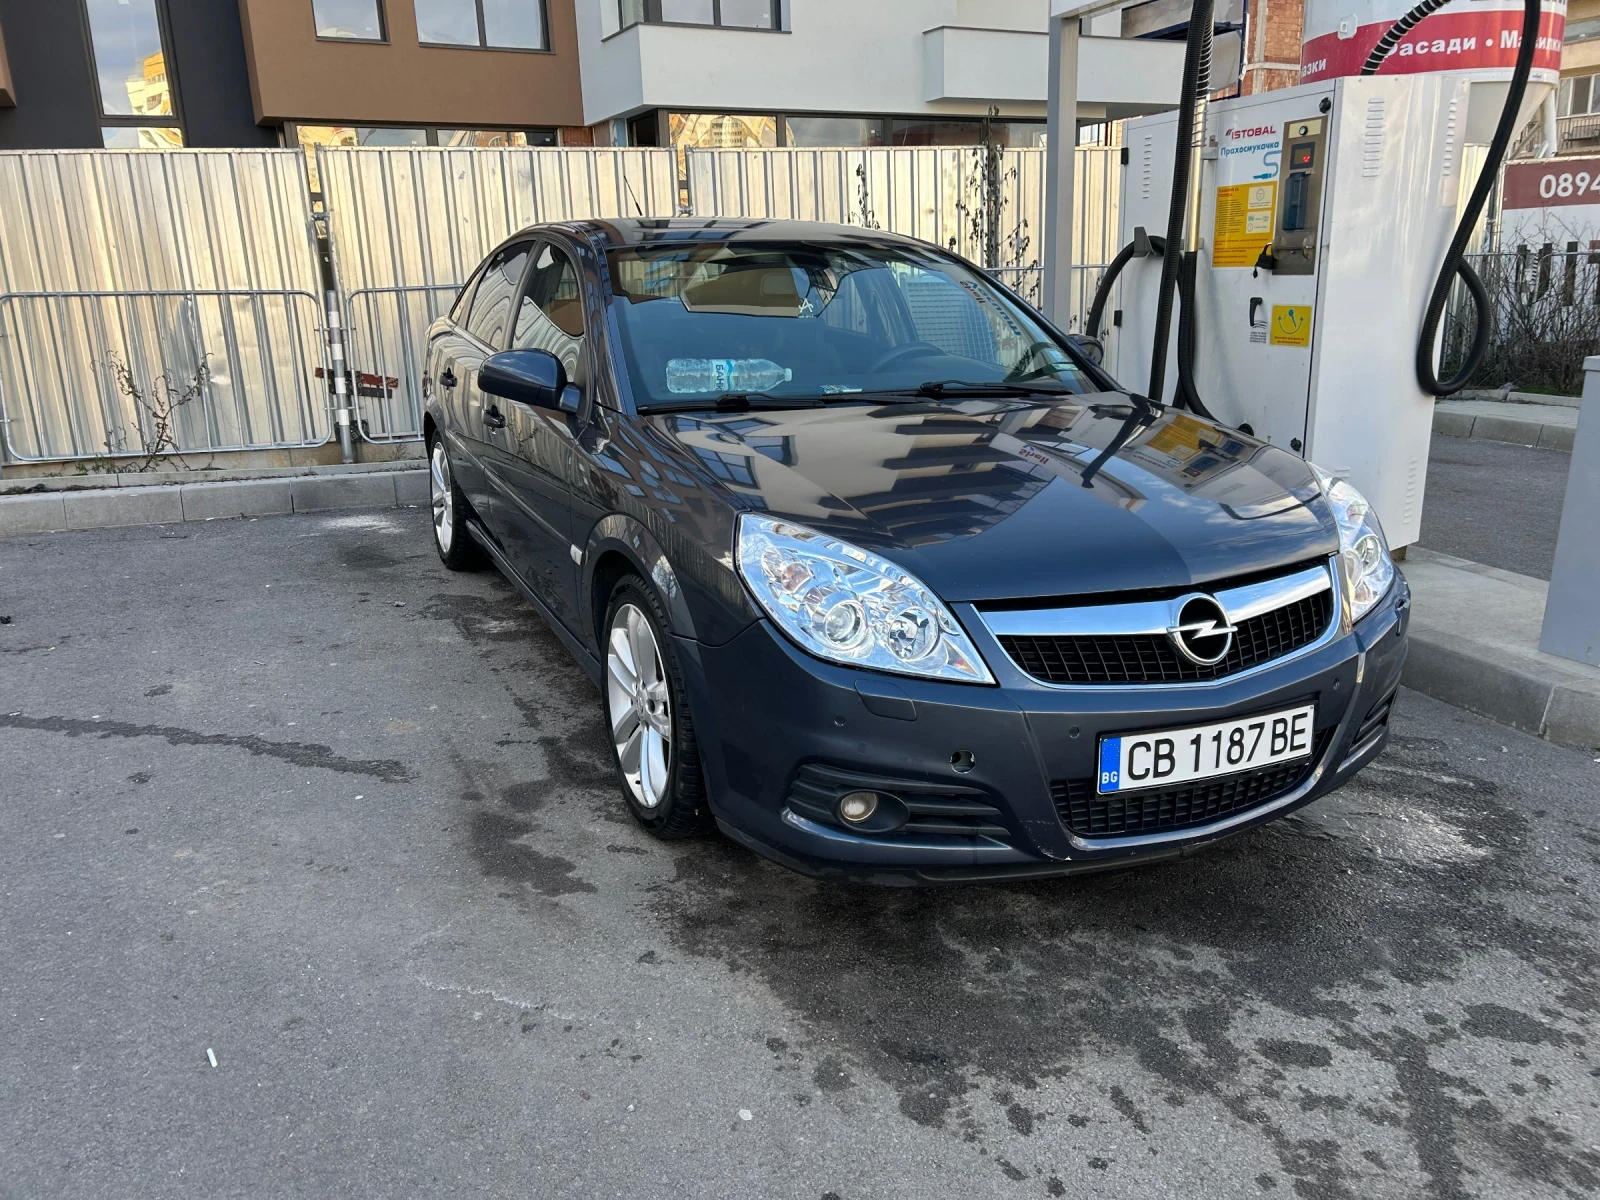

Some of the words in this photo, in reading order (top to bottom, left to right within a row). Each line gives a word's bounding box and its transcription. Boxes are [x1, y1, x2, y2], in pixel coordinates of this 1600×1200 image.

[1231, 125, 1276, 140] ISTOBAL
[1220, 141, 1280, 157] Прахосмукачка
[1127, 738, 1176, 781] CB
[1190, 721, 1266, 772] 1187
[1270, 712, 1308, 757] BE
[1101, 771, 1118, 785] BG
